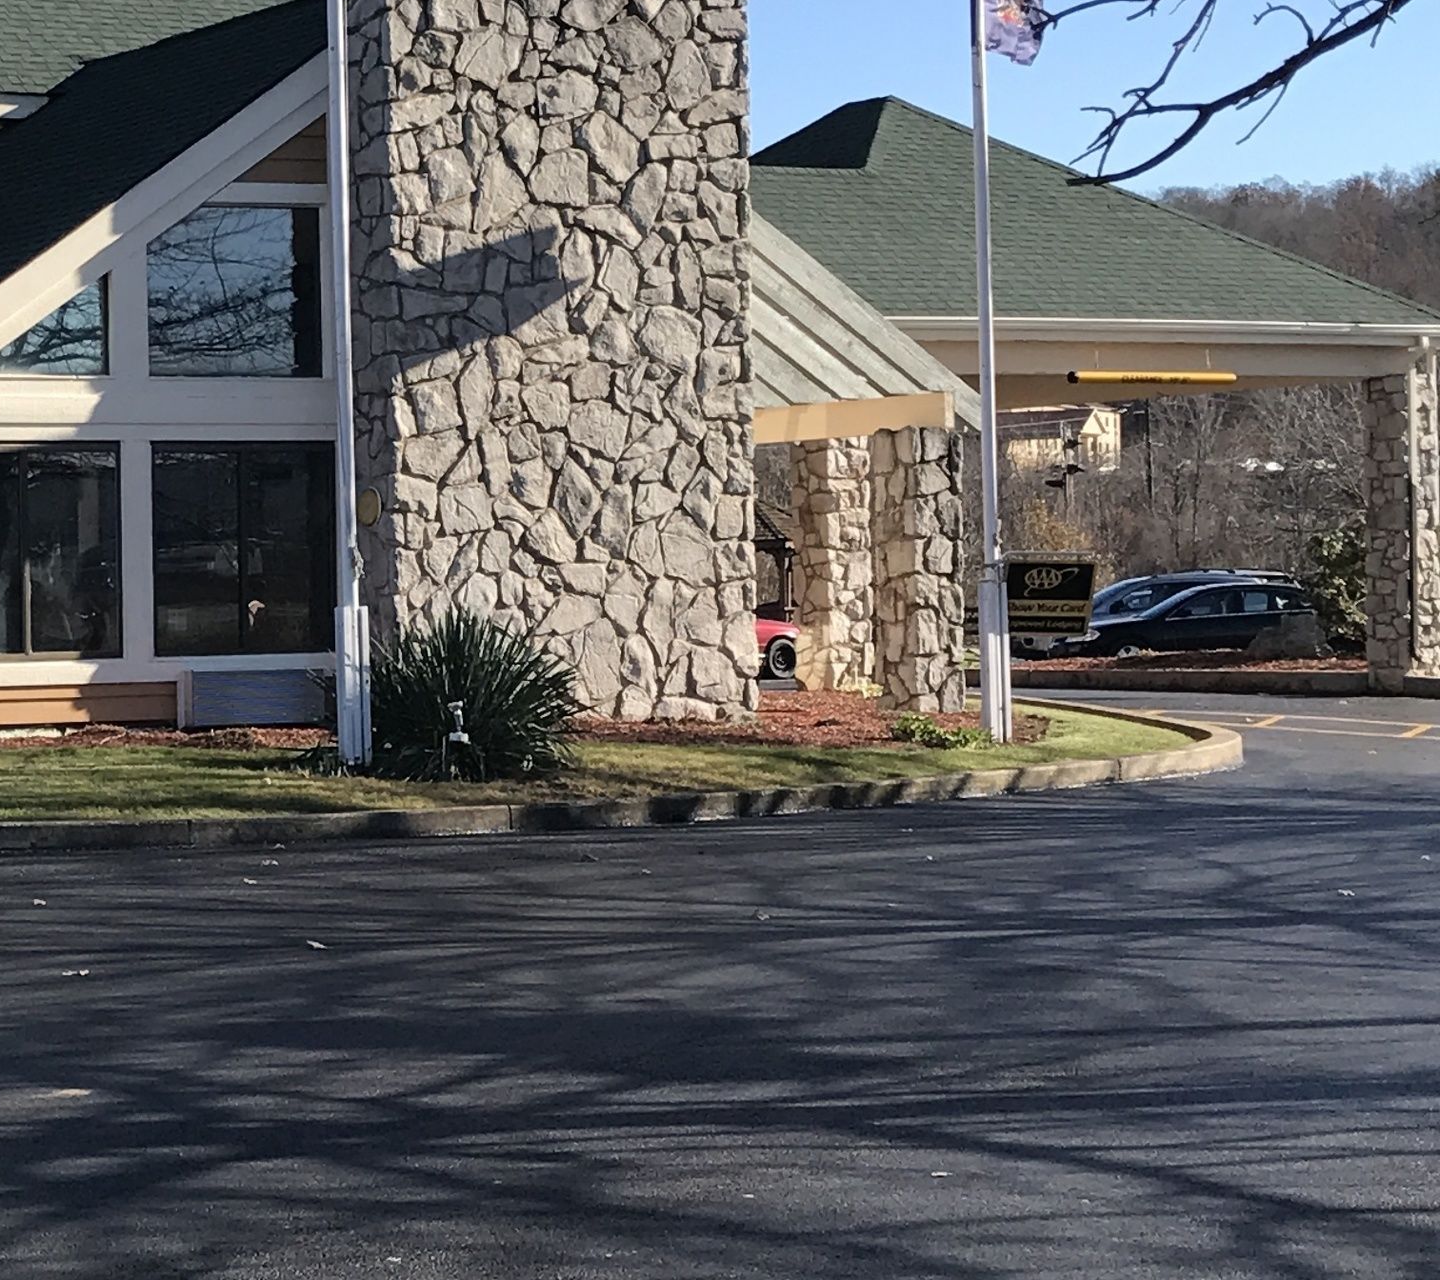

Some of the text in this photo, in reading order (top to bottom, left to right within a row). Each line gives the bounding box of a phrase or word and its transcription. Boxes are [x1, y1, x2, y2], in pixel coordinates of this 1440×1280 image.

[1027, 567, 1060, 586] AAA
[1037, 602, 1059, 612] Your
[1061, 602, 1086, 613] Card
